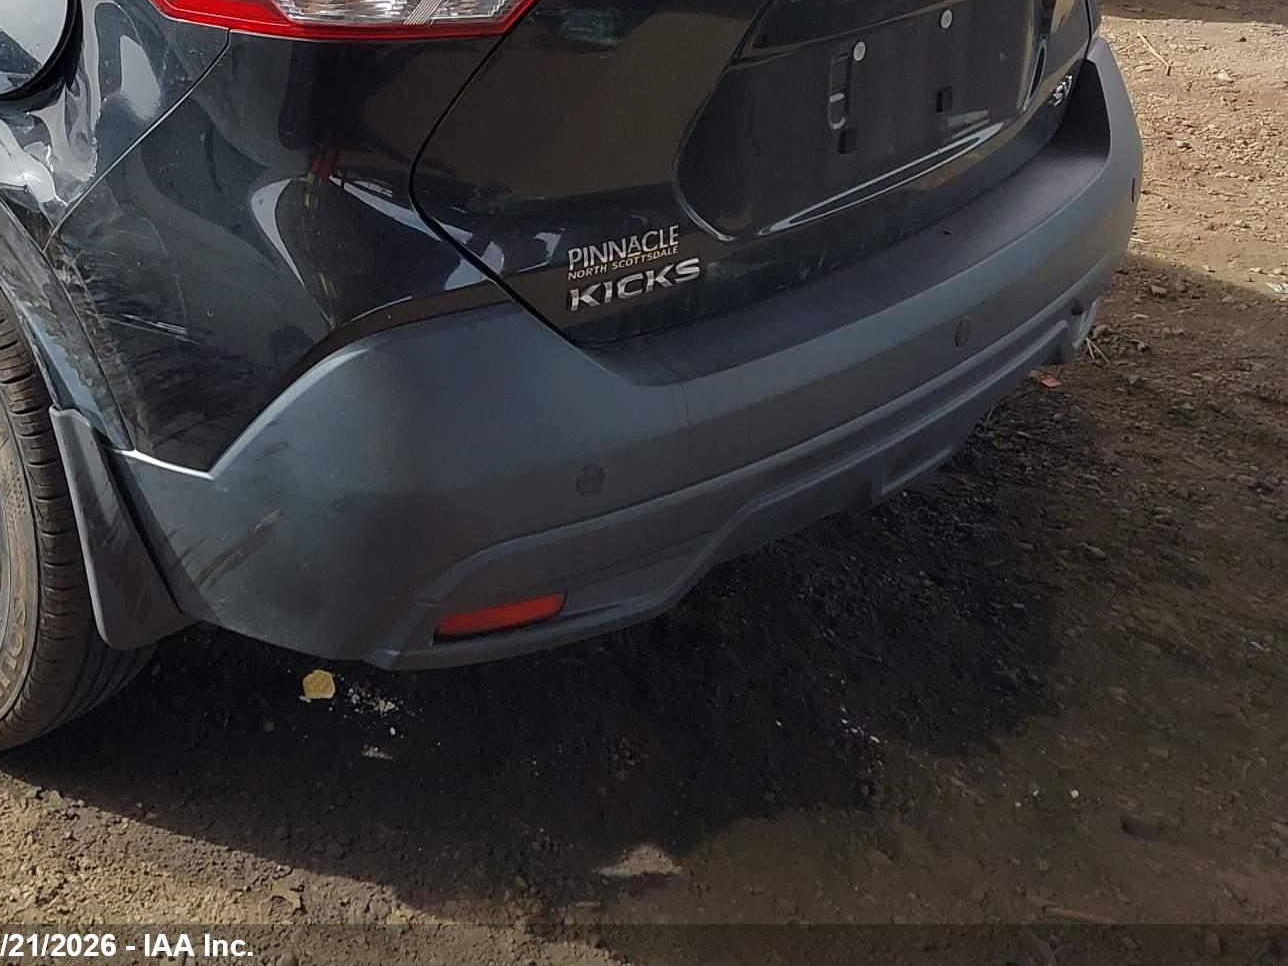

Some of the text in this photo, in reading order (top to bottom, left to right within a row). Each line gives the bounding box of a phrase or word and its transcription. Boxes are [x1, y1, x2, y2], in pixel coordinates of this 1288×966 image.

[567, 246, 679, 281] NORTH SCOTTSDALE
[568, 225, 680, 271] PINNACLE
[569, 257, 701, 312] KICKS
